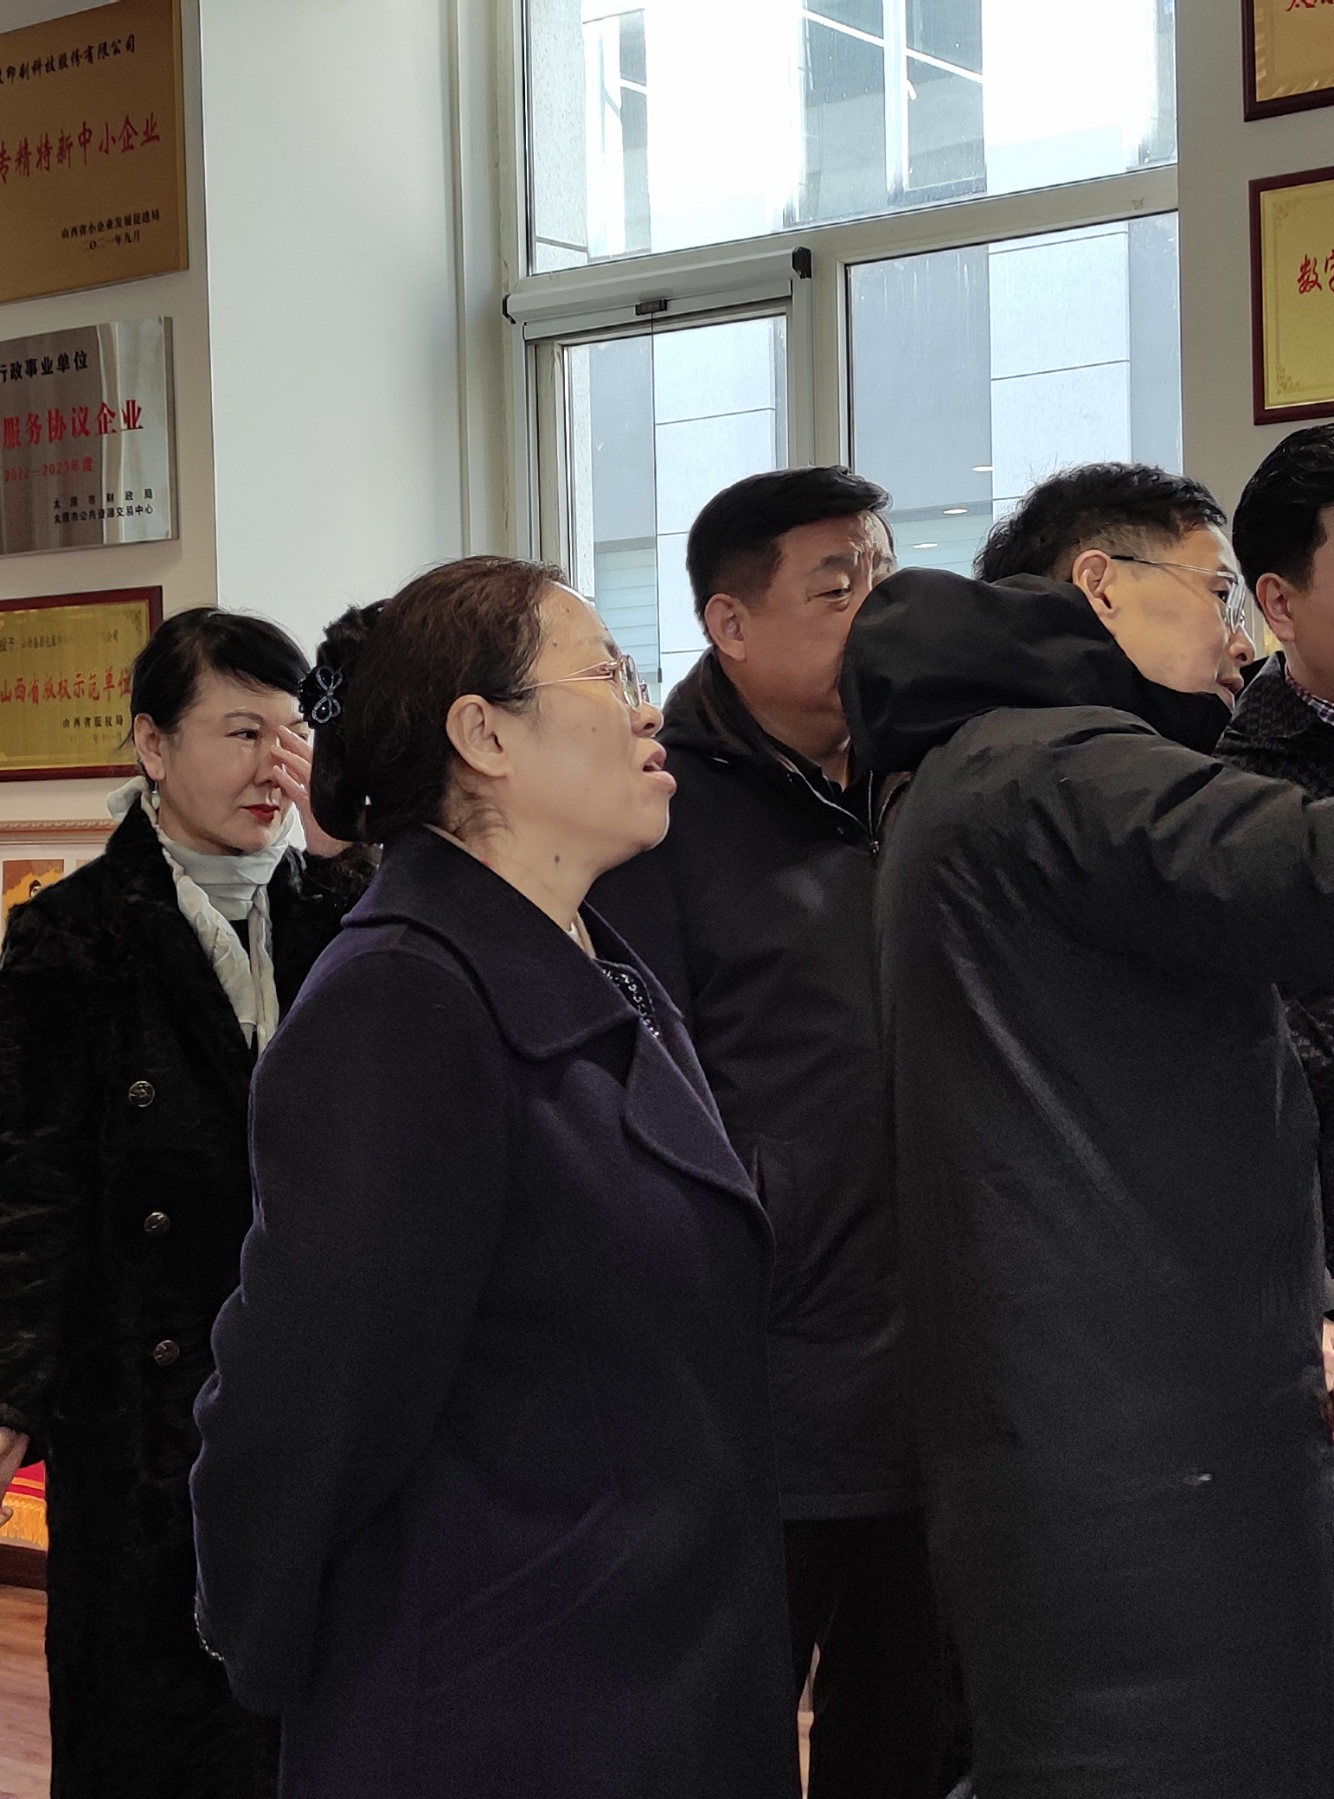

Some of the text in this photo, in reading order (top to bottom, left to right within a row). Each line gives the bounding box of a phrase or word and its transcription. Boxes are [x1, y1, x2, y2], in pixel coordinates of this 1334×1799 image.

[61, 209, 160, 239] 山西省小企业发展促进局
[53, 504, 153, 525] 太原市公共资源交易中心
[0, 666, 132, 706] 山西省版权示范单位
